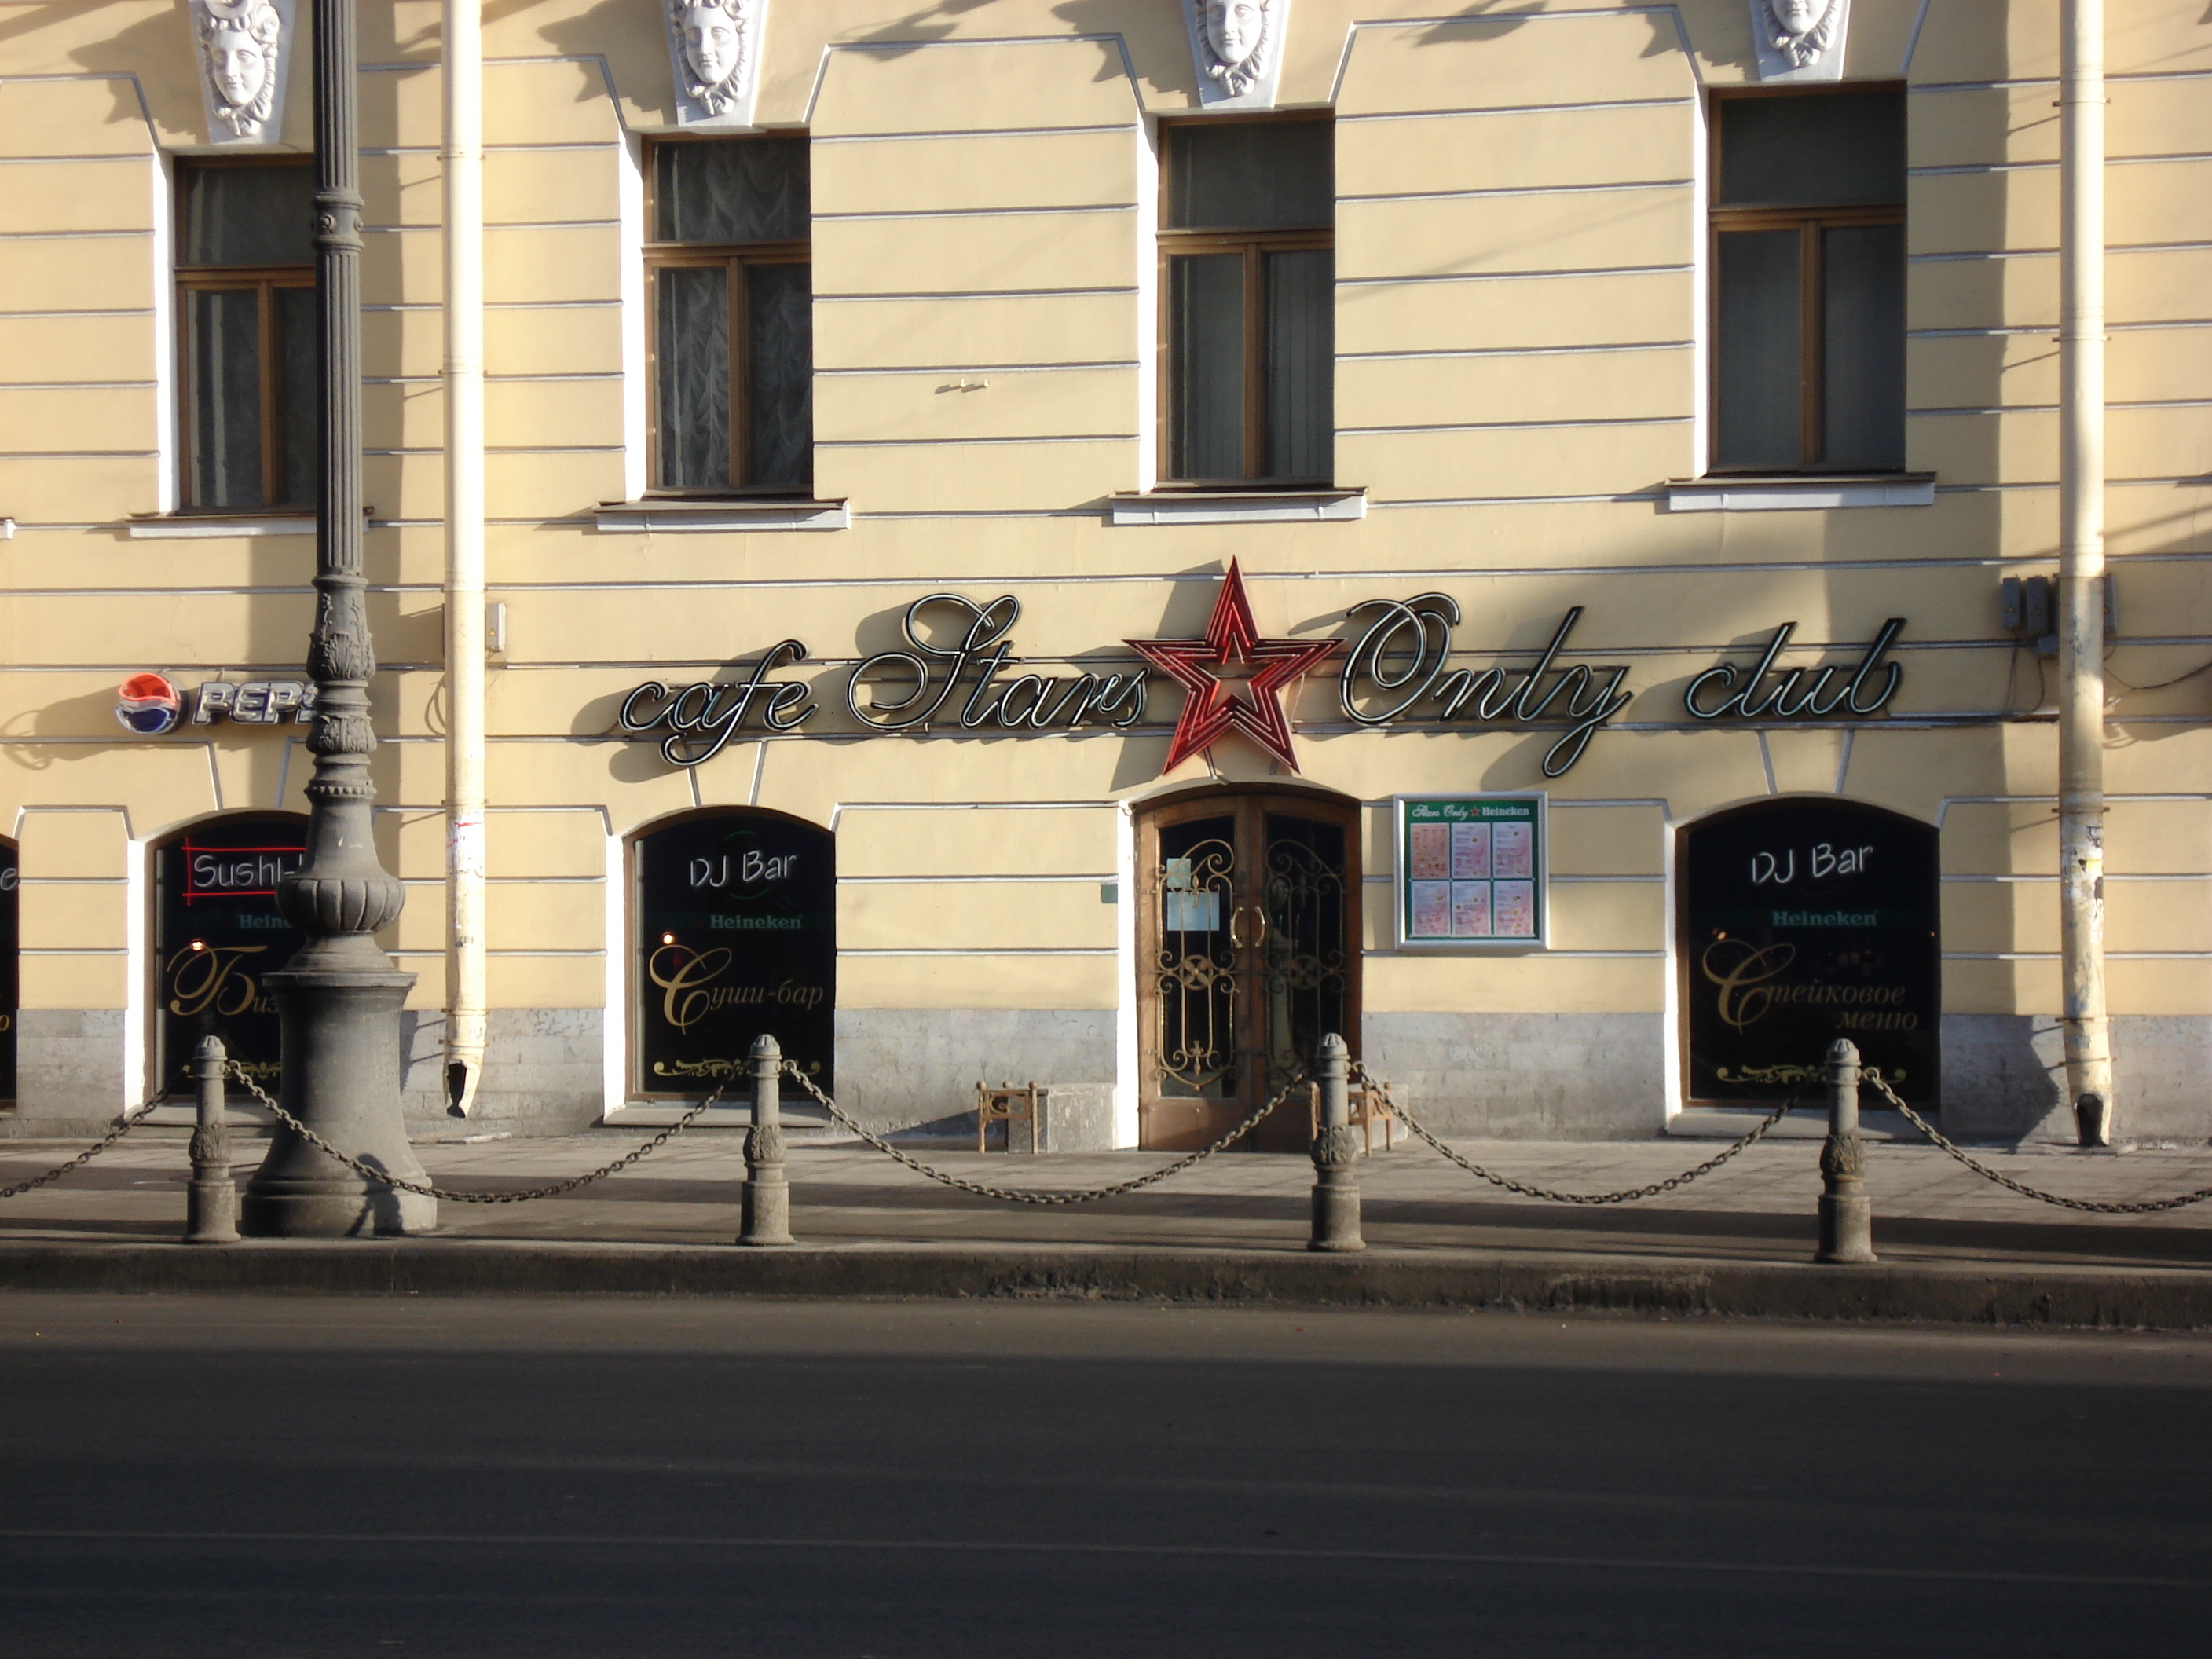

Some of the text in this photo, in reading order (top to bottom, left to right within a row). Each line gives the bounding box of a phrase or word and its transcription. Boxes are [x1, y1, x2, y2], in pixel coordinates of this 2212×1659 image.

[618, 591, 1907, 779] cafe Stars Only club
[1482, 806, 1530, 816] Heineken
[193, 853, 304, 888] Sushi-
[689, 849, 799, 888] DJ Bar
[1751, 843, 1874, 884] DJ Bar
[710, 914, 802, 930] Heineken
[1772, 910, 1878, 927] Heineken
[649, 944, 824, 1035] Суши-бар
[1701, 939, 1906, 1035] Стейковое
[1837, 1010, 1918, 1031] меню
